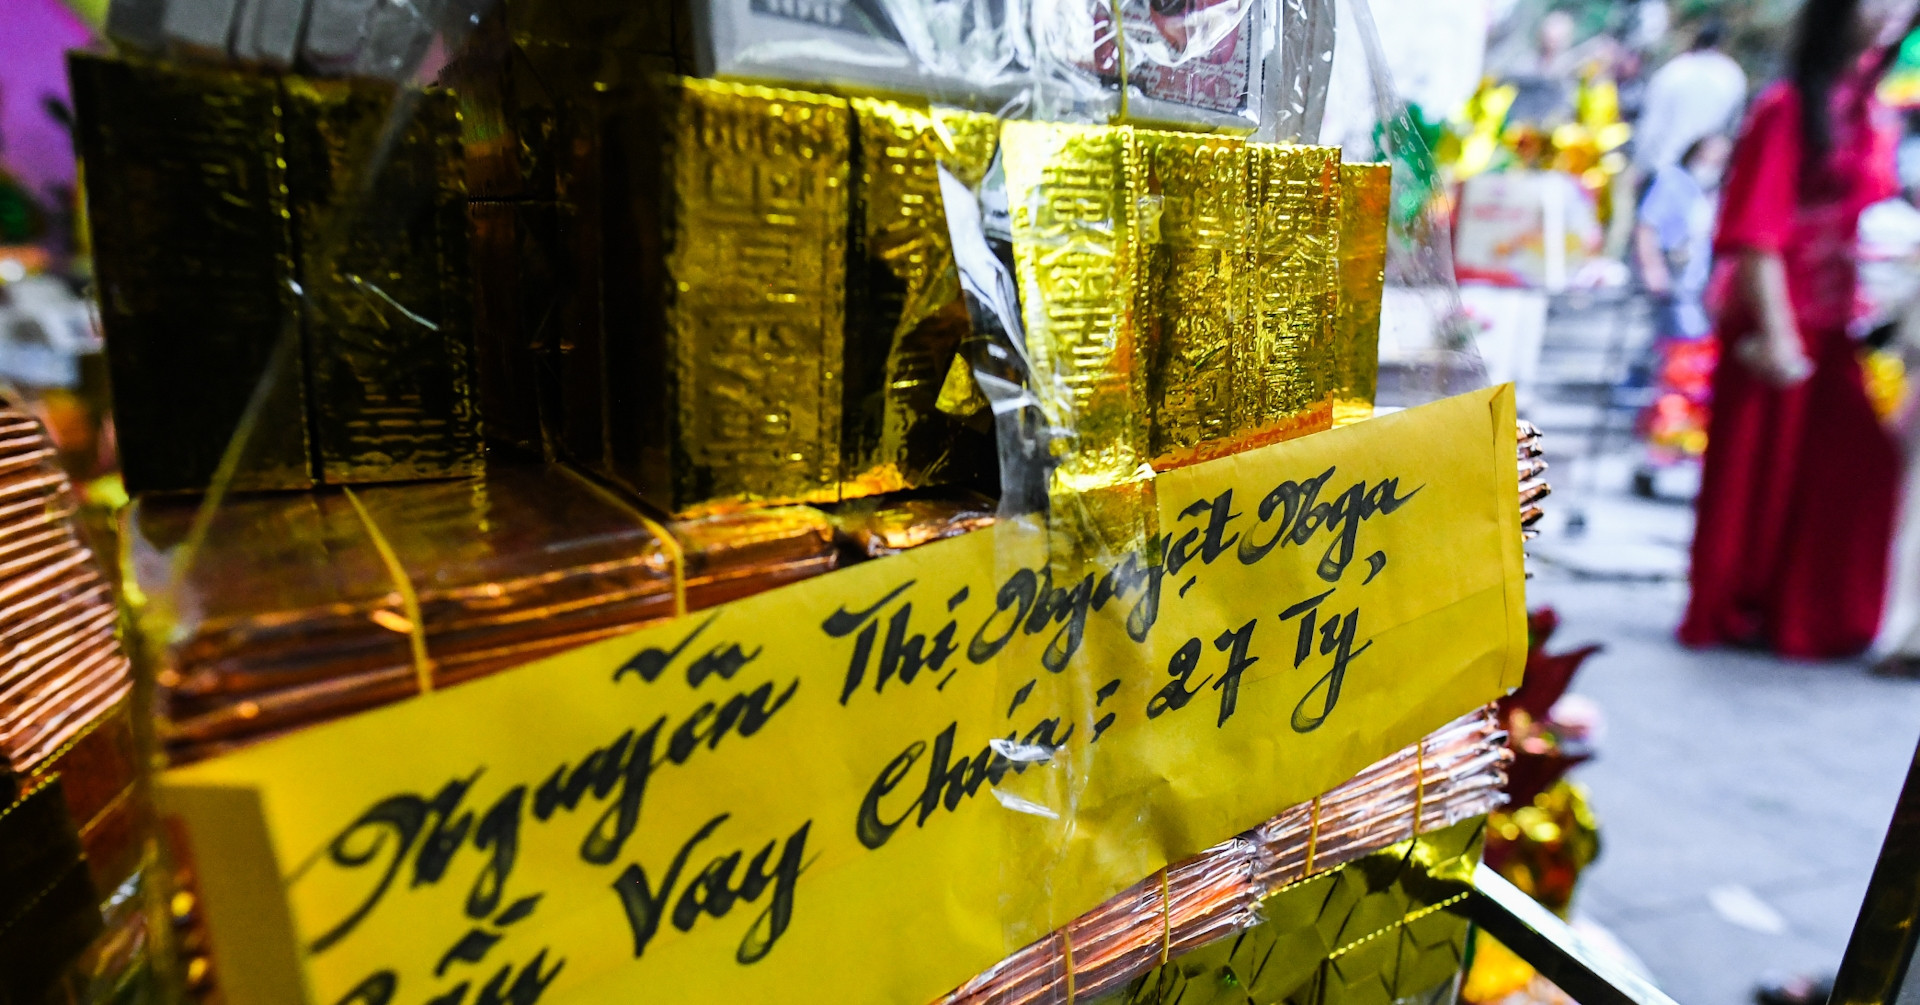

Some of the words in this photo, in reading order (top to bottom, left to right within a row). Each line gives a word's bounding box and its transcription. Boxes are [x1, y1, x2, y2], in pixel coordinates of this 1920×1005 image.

[284, 613, 799, 954] Nguyễn
[822, 579, 969, 706] Thị
[1238, 466, 1427, 583] Nga
[612, 814, 821, 965] Vay
[1146, 618, 1259, 729] 27
